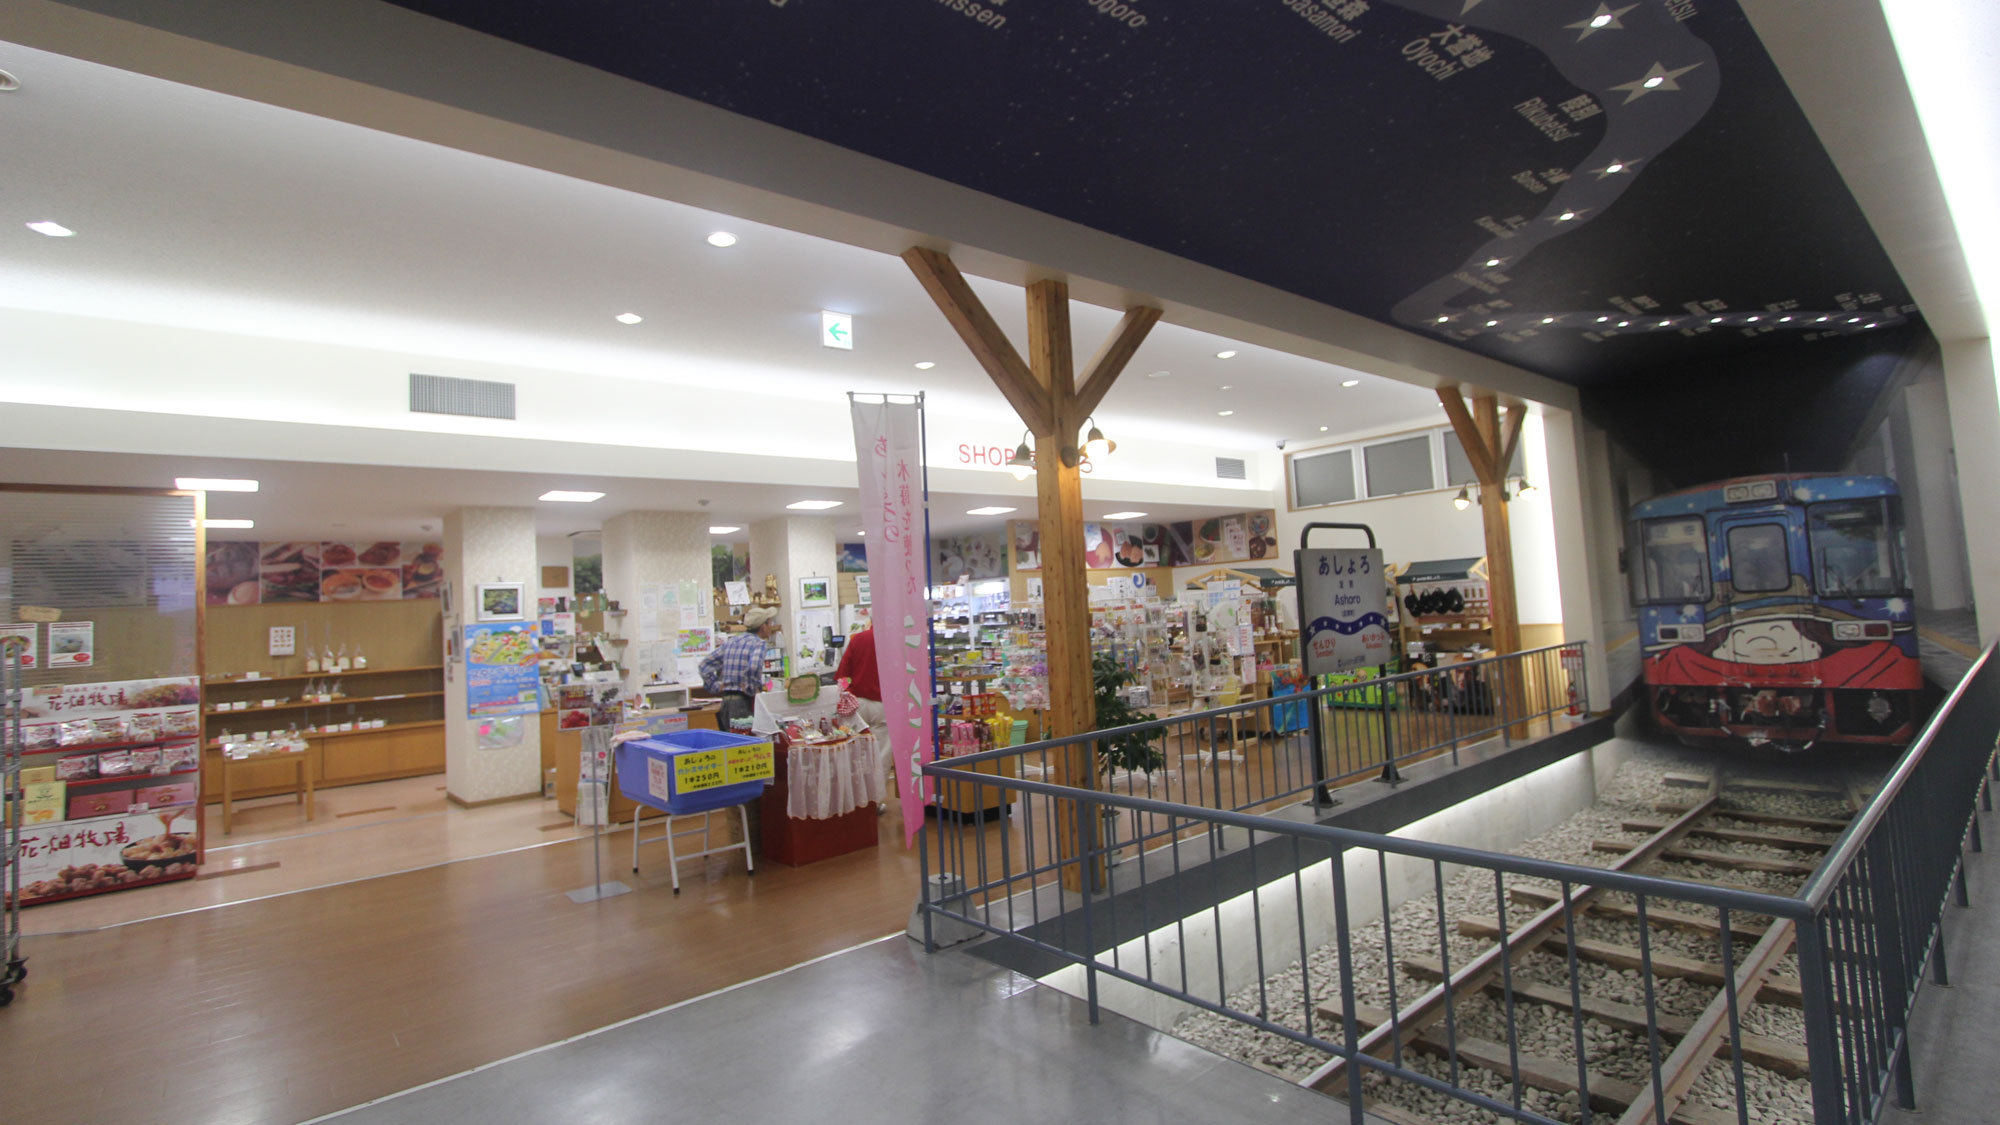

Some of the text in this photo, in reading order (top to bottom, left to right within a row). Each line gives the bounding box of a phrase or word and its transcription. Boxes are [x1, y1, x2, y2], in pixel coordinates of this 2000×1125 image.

[1402, 38, 1464, 81] Oyochi
[1513, 96, 1573, 142] Rikubetsu
[959, 444, 1015, 466] SHOP
[1319, 555, 1370, 576] あしょろ
[1335, 593, 1361, 606] Ashoro
